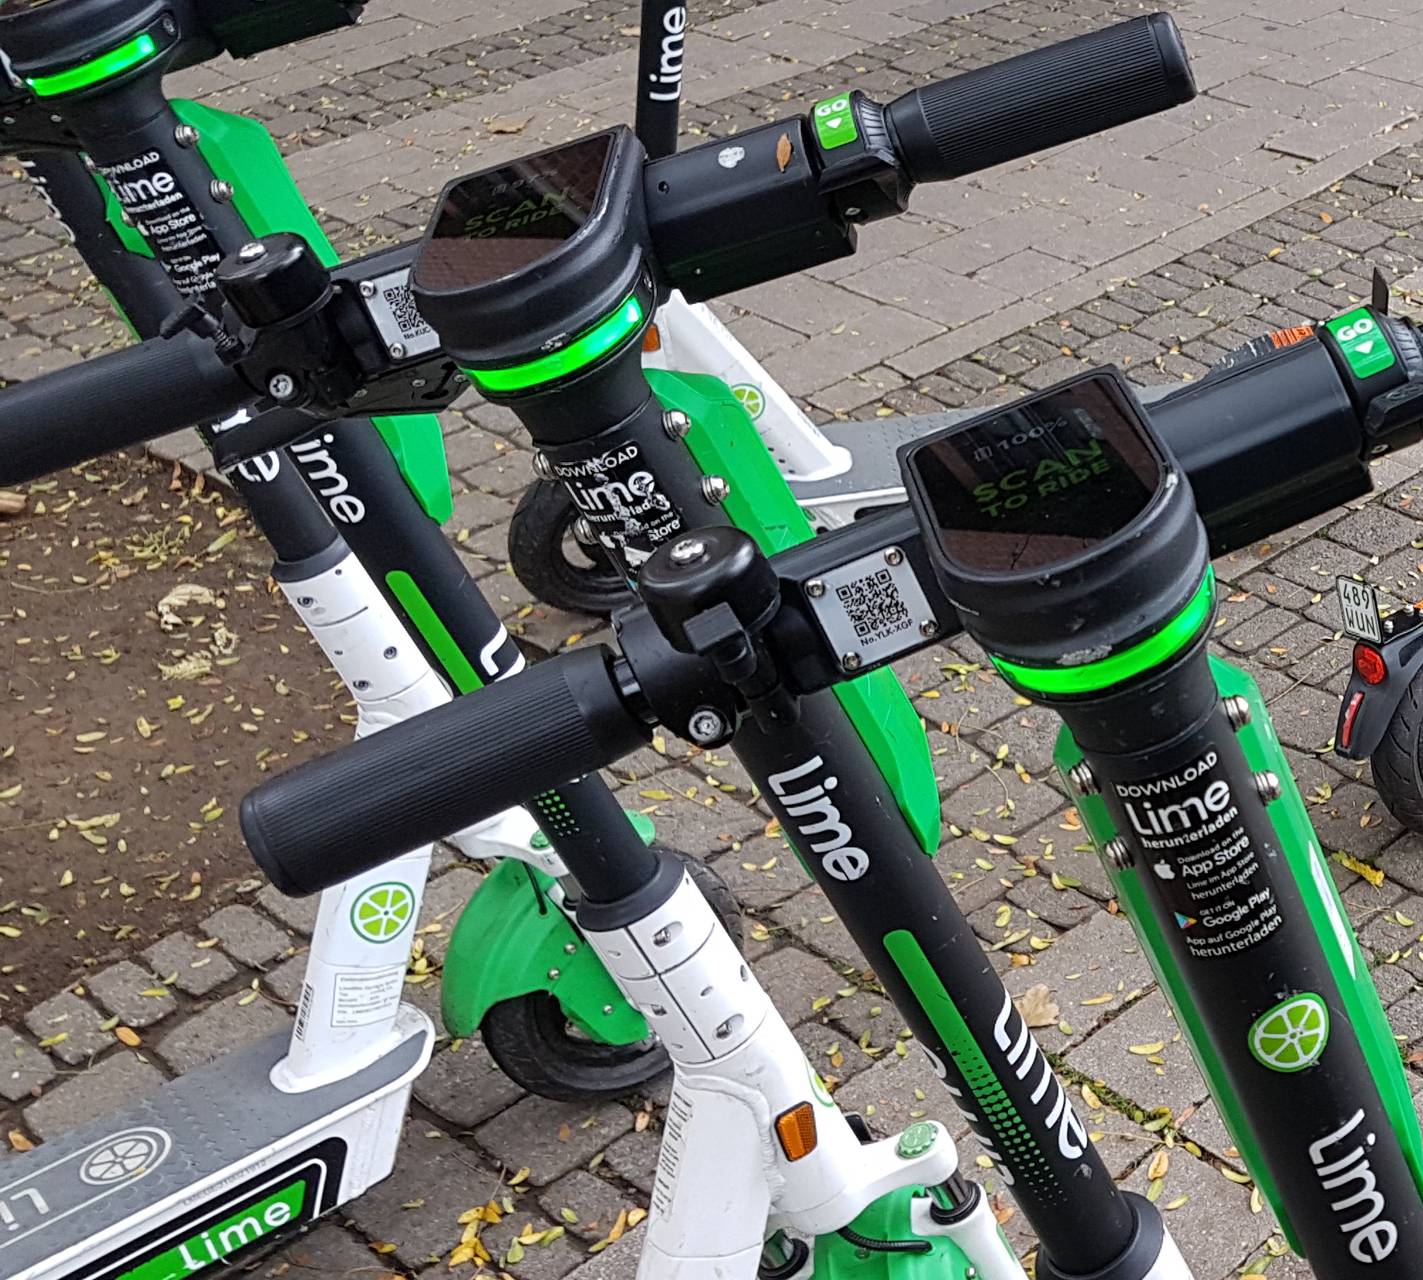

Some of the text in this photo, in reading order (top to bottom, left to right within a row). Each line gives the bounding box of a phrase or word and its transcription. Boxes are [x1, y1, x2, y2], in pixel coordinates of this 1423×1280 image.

[649, 6, 686, 101] Lime
[815, 99, 848, 117] GO
[168, 213, 197, 230] Store
[1337, 317, 1373, 341] GO
[290, 433, 365, 524] ime
[564, 471, 655, 511] Lime
[972, 438, 1102, 502] SCAN
[979, 458, 1111, 518] TO RIDE
[1343, 583, 1371, 610] 489
[1346, 606, 1376, 637] WUN
[1116, 751, 1217, 798] DOWNLOAD
[768, 755, 870, 881] Lime
[1124, 780, 1230, 836] Lime
[1177, 843, 1221, 865] Download
[1182, 835, 1250, 878] App Store
[1221, 865, 1238, 879] App
[1190, 861, 1259, 900] herunterladen
[1202, 886, 1271, 928] Google Play
[1189, 914, 1283, 957] herunterladen
[1224, 918, 1260, 940] Google
[1309, 1108, 1398, 1264] Lime
[178, 1200, 291, 1271] Lime
